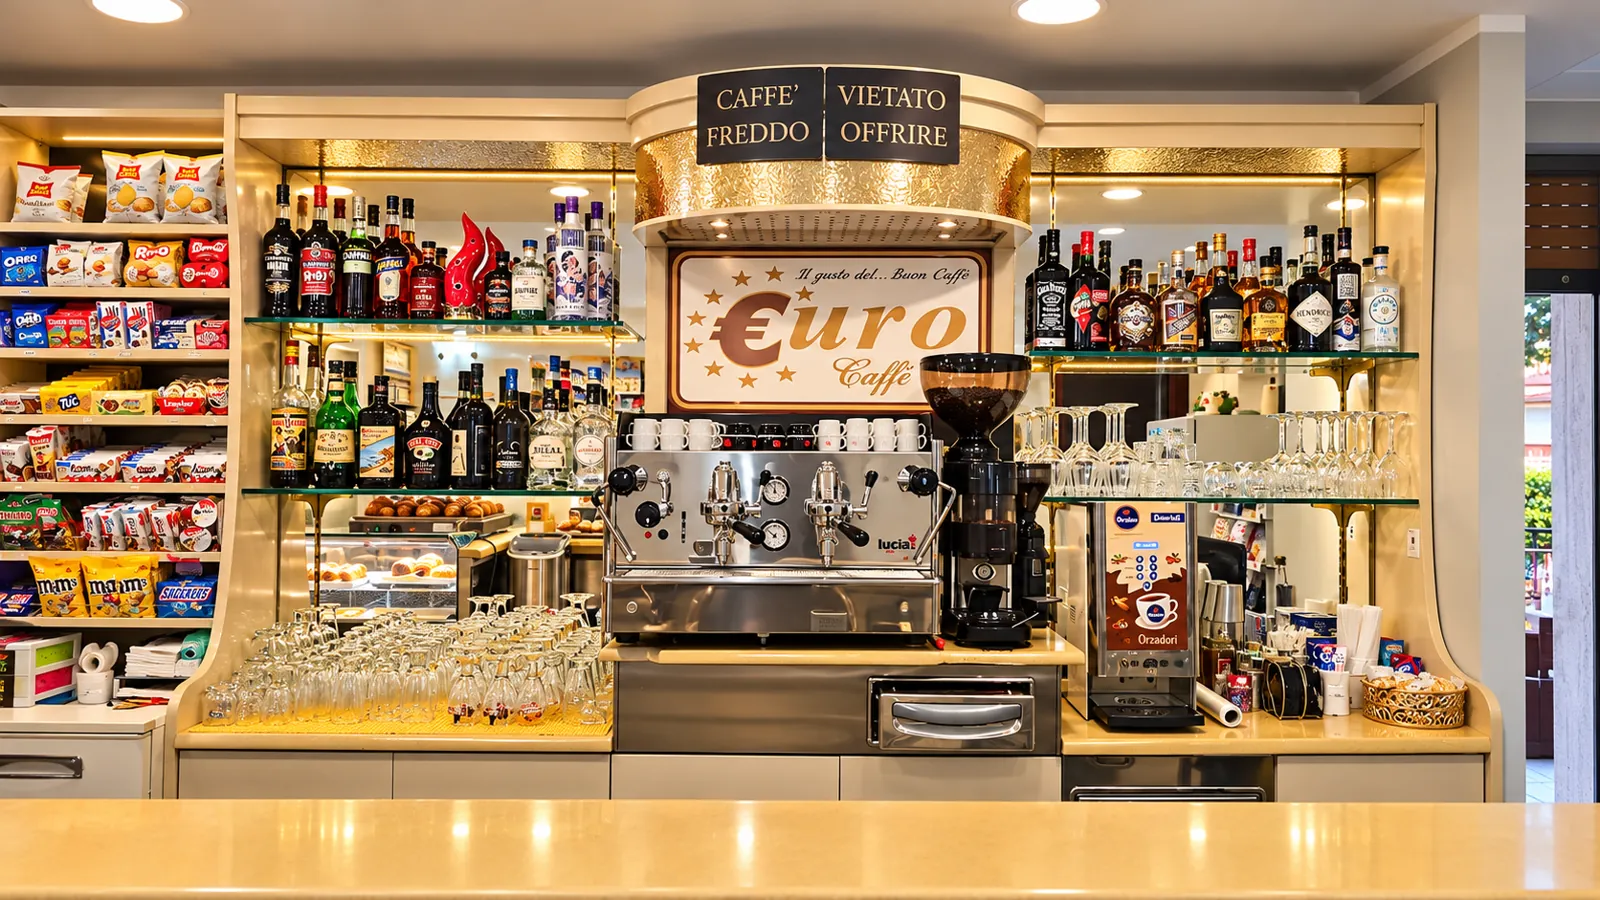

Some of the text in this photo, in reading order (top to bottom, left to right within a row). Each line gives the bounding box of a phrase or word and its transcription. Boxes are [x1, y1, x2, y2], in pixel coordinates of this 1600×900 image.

[838, 84, 947, 111] VIETATO
[706, 121, 810, 148] FREDDO
[841, 121, 948, 147] OFFRIRE
[795, 268, 813, 281] Il
[812, 268, 850, 285] gusto
[890, 268, 927, 281] Buon
[60, 393, 79, 410] TUC
[1137, 633, 1178, 646] Orzadori
